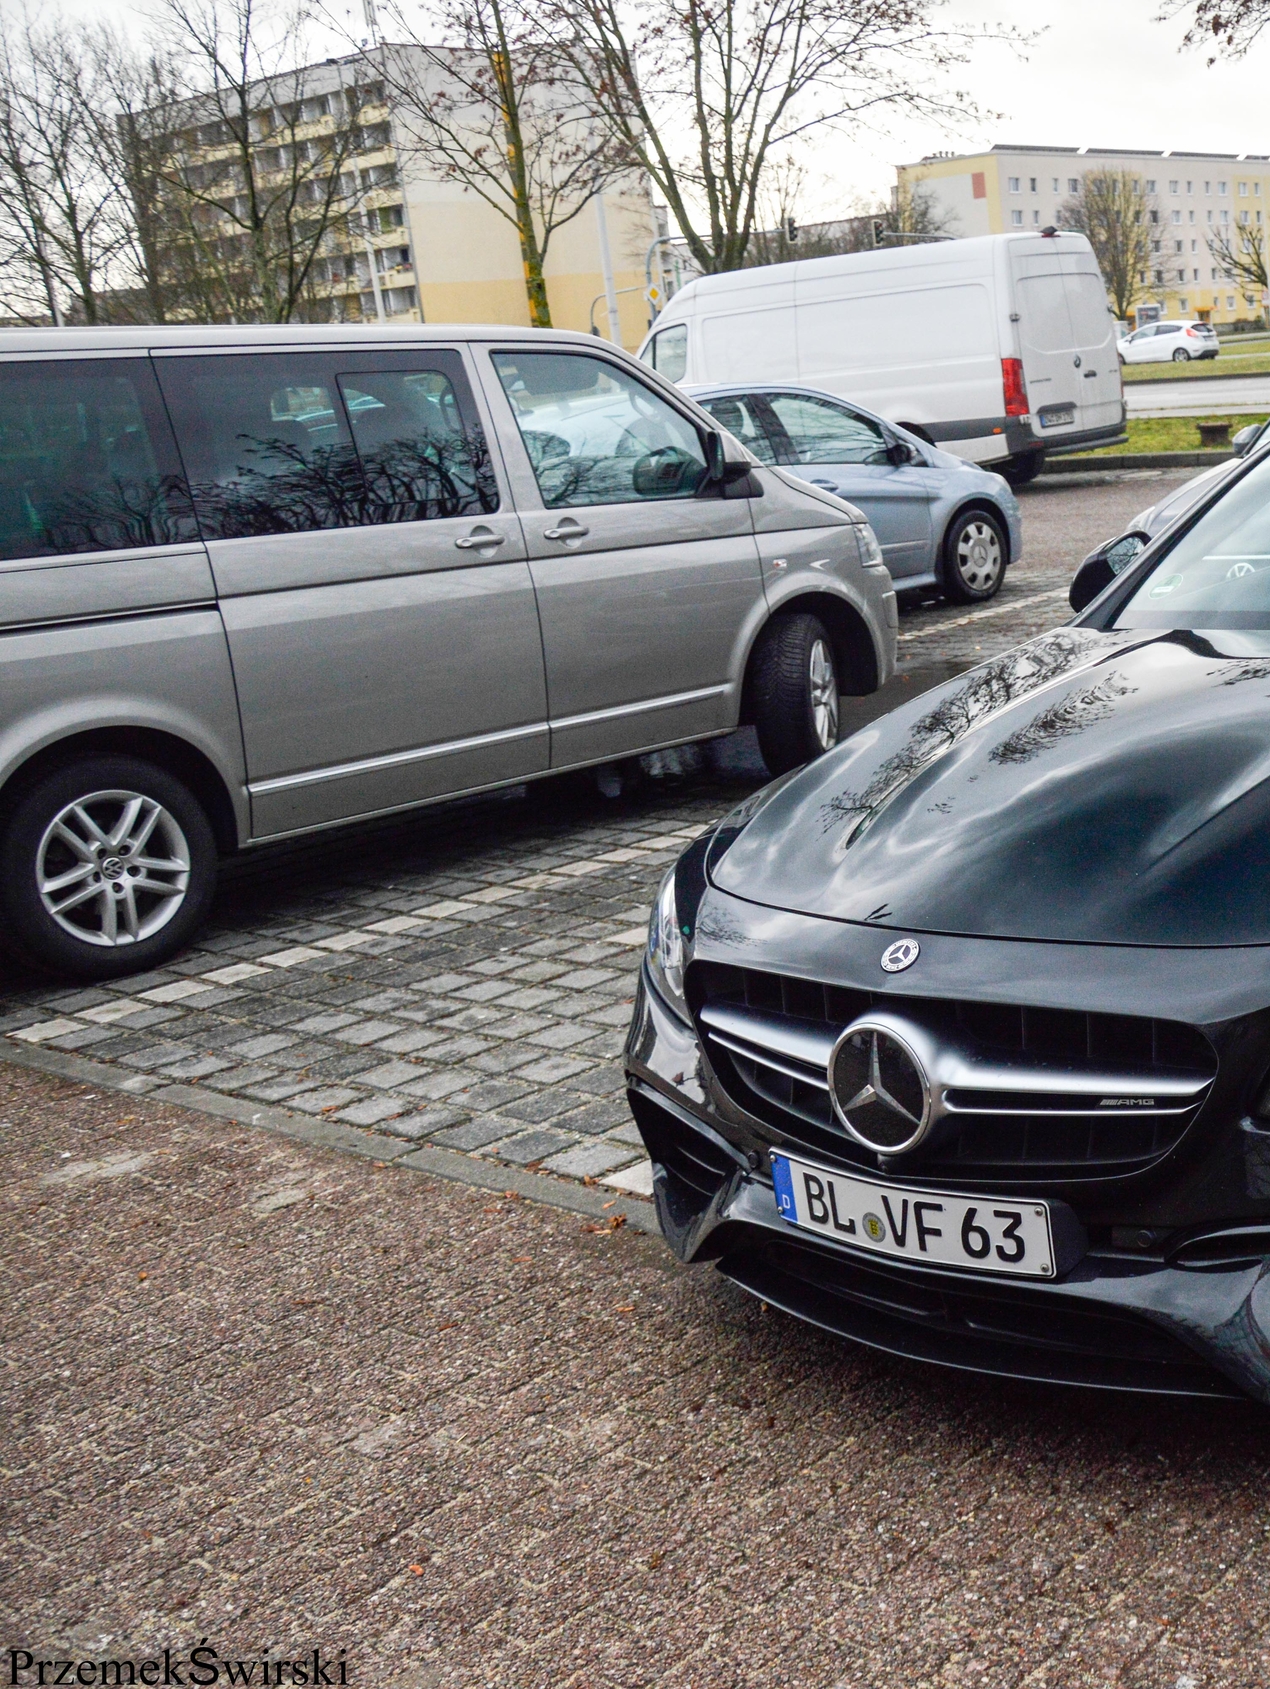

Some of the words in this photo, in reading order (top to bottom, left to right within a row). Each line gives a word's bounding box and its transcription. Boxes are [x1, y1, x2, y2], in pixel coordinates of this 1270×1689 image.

[1117, 1098, 1155, 1106] AMG
[782, 1193, 791, 1209] D
[802, 1171, 857, 1236] BL
[880, 1194, 944, 1252] VF
[960, 1206, 1026, 1263] 63
